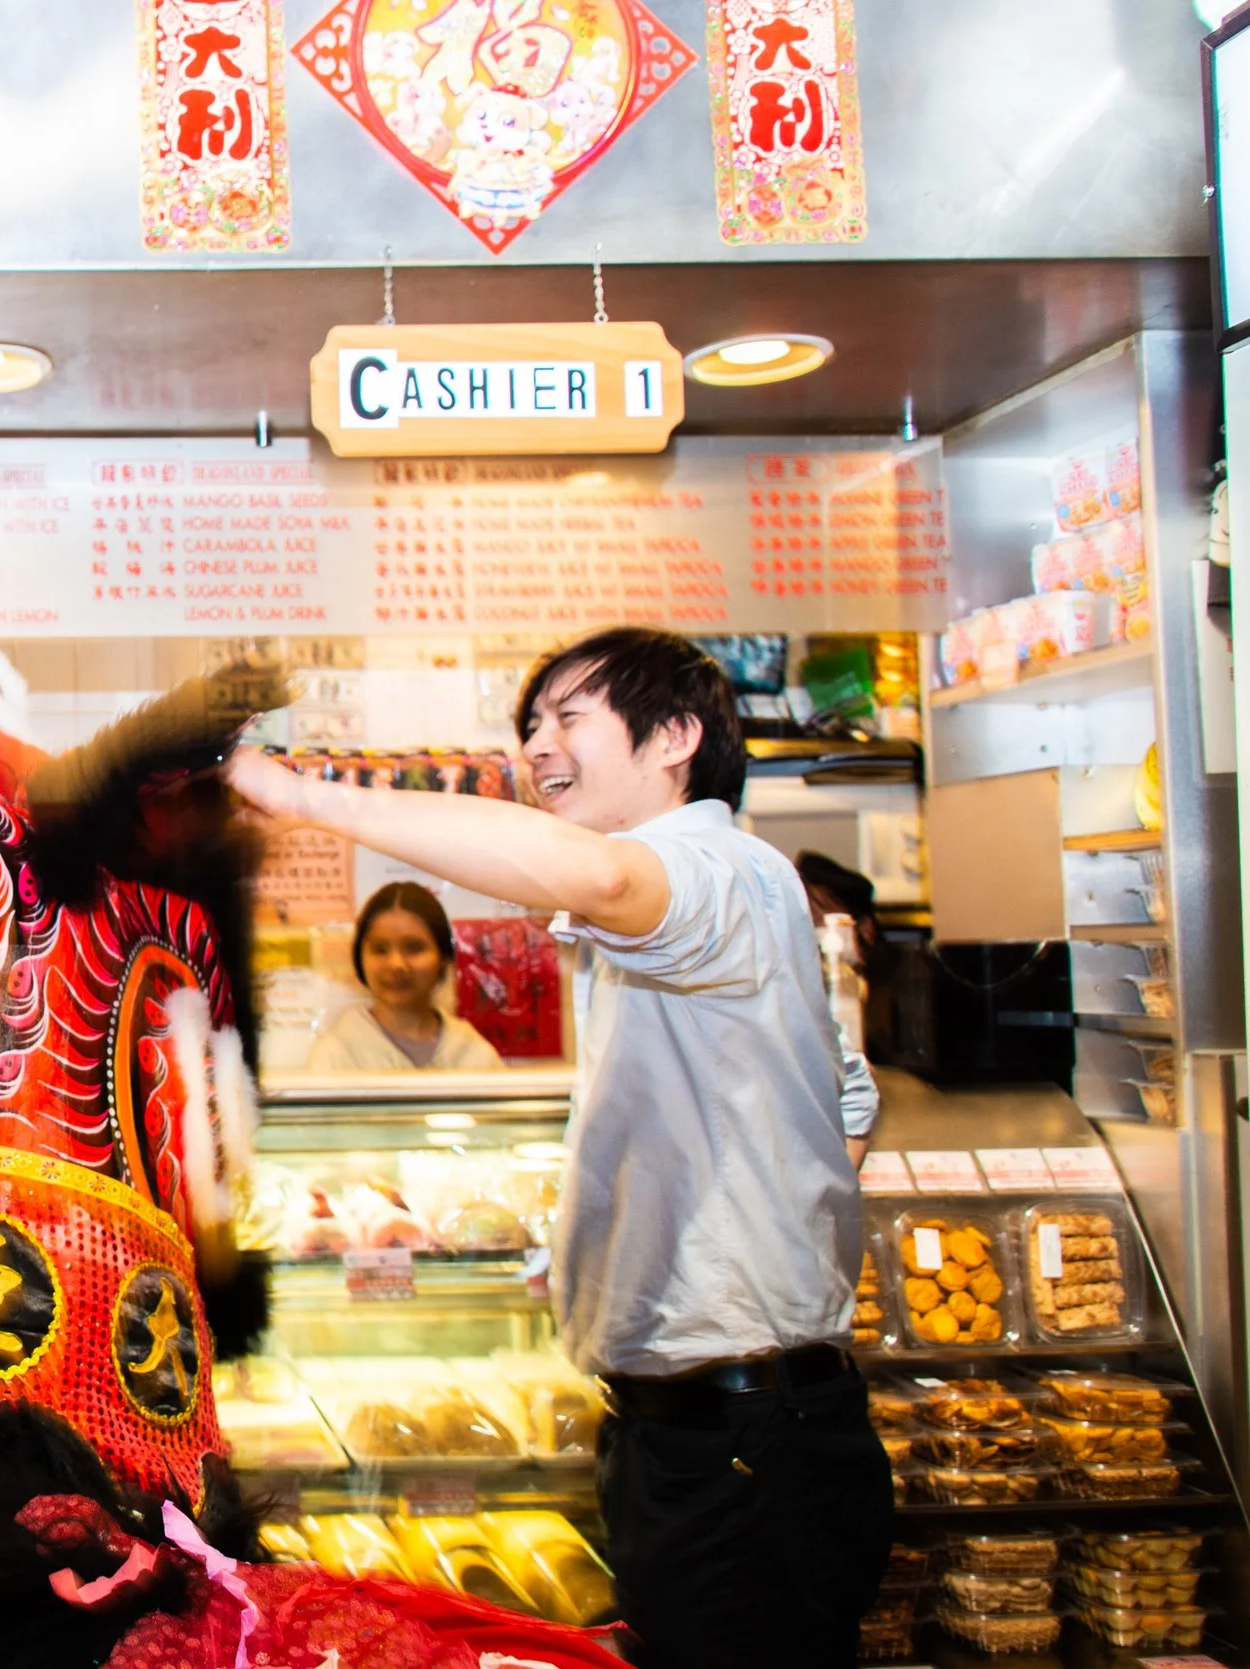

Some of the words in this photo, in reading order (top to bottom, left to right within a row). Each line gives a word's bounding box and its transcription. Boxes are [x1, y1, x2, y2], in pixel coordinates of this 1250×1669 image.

[749, 17, 823, 152] 大利
[177, 26, 251, 160] 大利
[350, 356, 587, 420] CASHIER
[637, 369, 652, 409] 1
[52, 497, 70, 511] ICE
[182, 494, 242, 507] MANGO
[41, 519, 59, 534] ICE
[182, 516, 223, 531] HOME
[230, 516, 270, 531] MADE
[278, 516, 313, 531] SOYA
[321, 516, 350, 531] MILK
[183, 539, 276, 553] CARAMBOLA
[285, 539, 317, 553] JUICE
[183, 560, 237, 575] CHINESE
[243, 560, 278, 575] PLUM
[285, 560, 318, 575] JUICE
[184, 583, 265, 598] SUGARCANE
[273, 583, 303, 598] JUICE
[11, 608, 59, 623] LEMON
[184, 606, 231, 621] LEMON
[250, 606, 283, 621] PLUM
[289, 606, 327, 621] DRINK
